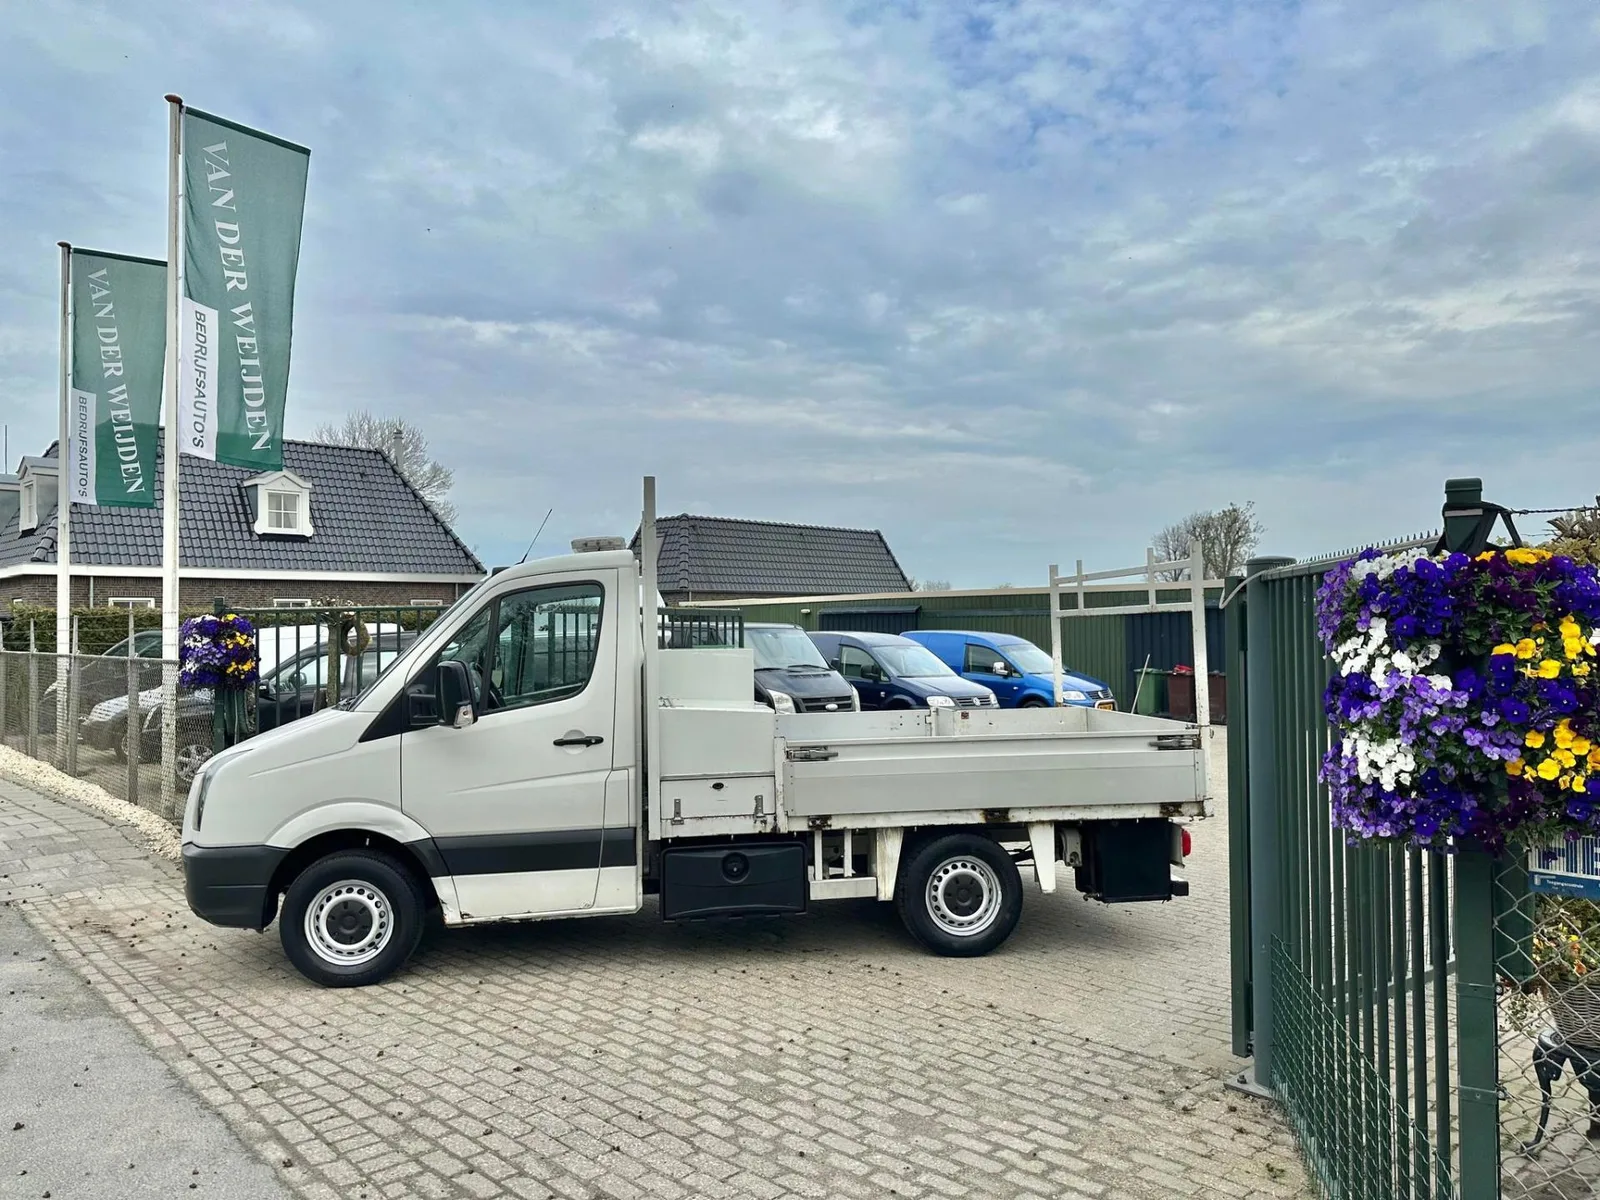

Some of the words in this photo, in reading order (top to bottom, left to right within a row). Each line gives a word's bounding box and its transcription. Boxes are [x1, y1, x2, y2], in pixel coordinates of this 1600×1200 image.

[202, 140, 237, 213] VAN
[88, 267, 116, 320] VAN
[214, 218, 248, 292] DER
[96, 325, 124, 379] DER
[192, 309, 207, 449] BEDRIJFSAUTO'S
[230, 301, 272, 451] WEIJDEN
[78, 395, 88, 498] BEDRIJFSAUTO'S
[107, 383, 146, 493] WEIJDEN
